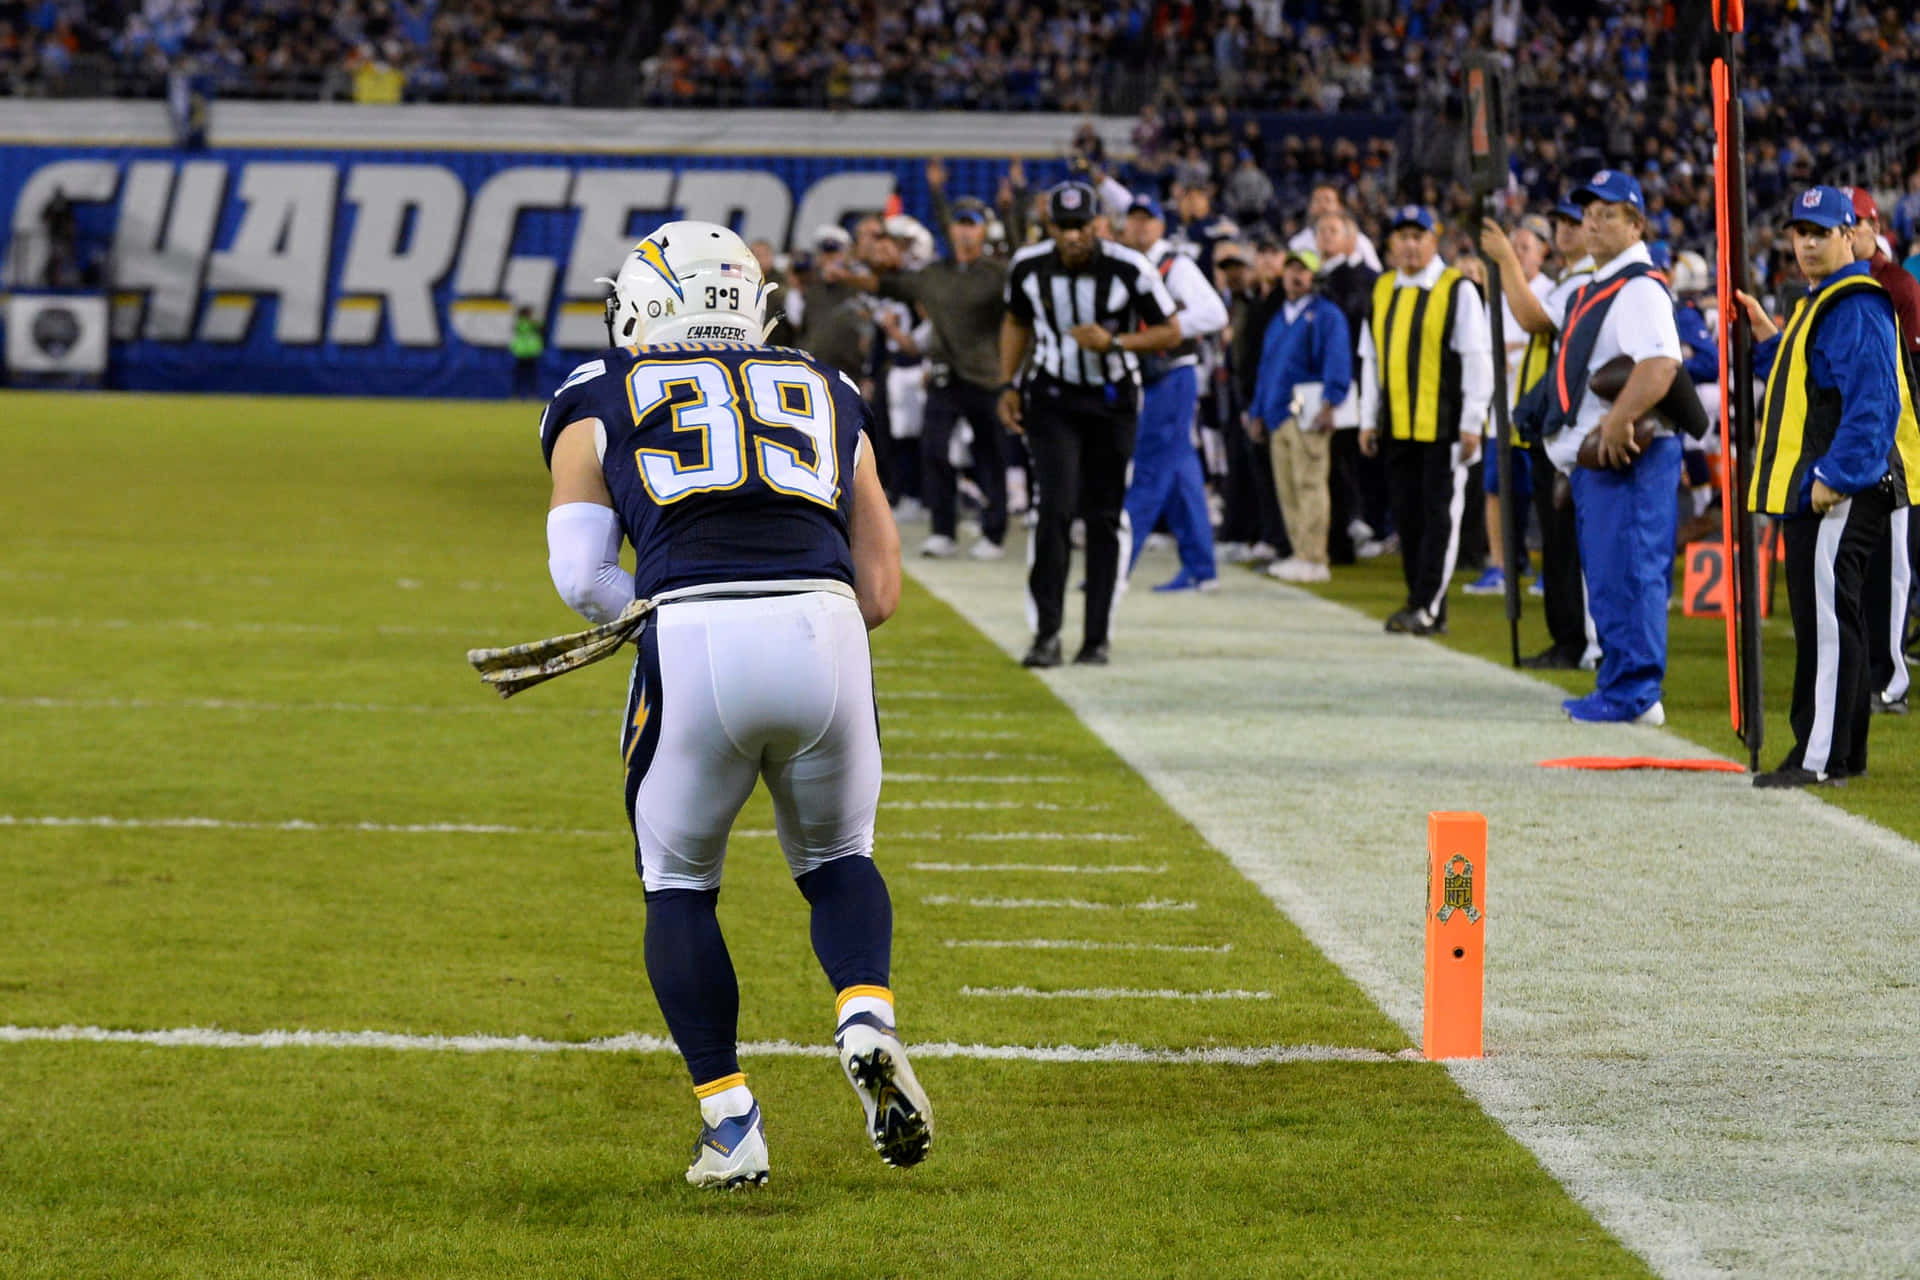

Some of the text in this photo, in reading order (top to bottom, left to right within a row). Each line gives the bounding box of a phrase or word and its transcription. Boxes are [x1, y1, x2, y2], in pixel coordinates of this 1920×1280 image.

[687, 326, 747, 341] CHARGERS
[626, 357, 841, 510] 39
[1448, 889, 1470, 904] NFL
